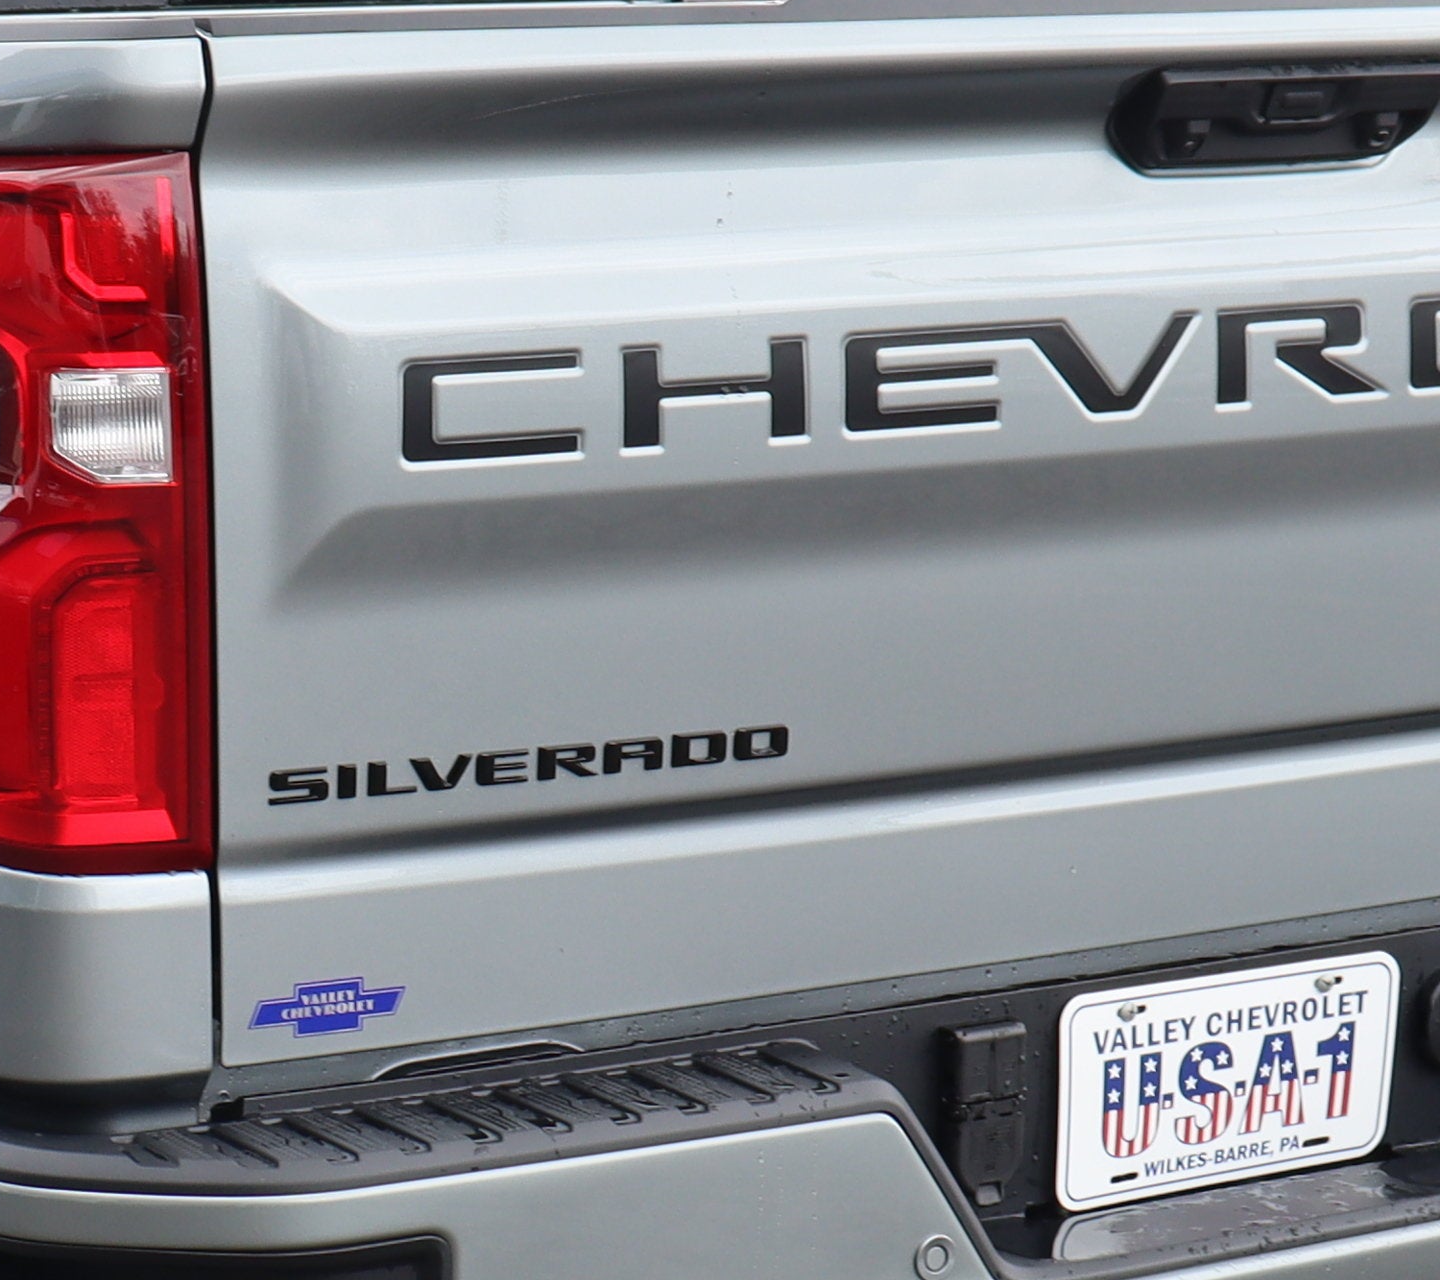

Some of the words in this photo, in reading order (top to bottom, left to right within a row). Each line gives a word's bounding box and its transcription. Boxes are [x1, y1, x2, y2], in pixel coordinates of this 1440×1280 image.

[267, 724, 789, 806] SILVERADO
[281, 999, 374, 1020] CHEVROLET
[300, 989, 357, 1006] VALLEY
[1093, 1015, 1196, 1054] VALLEY
[1206, 990, 1369, 1037] CHEVROLET
[1143, 1139, 1274, 1178] WILKES-BARRE,
[1280, 1135, 1301, 1152] PA
